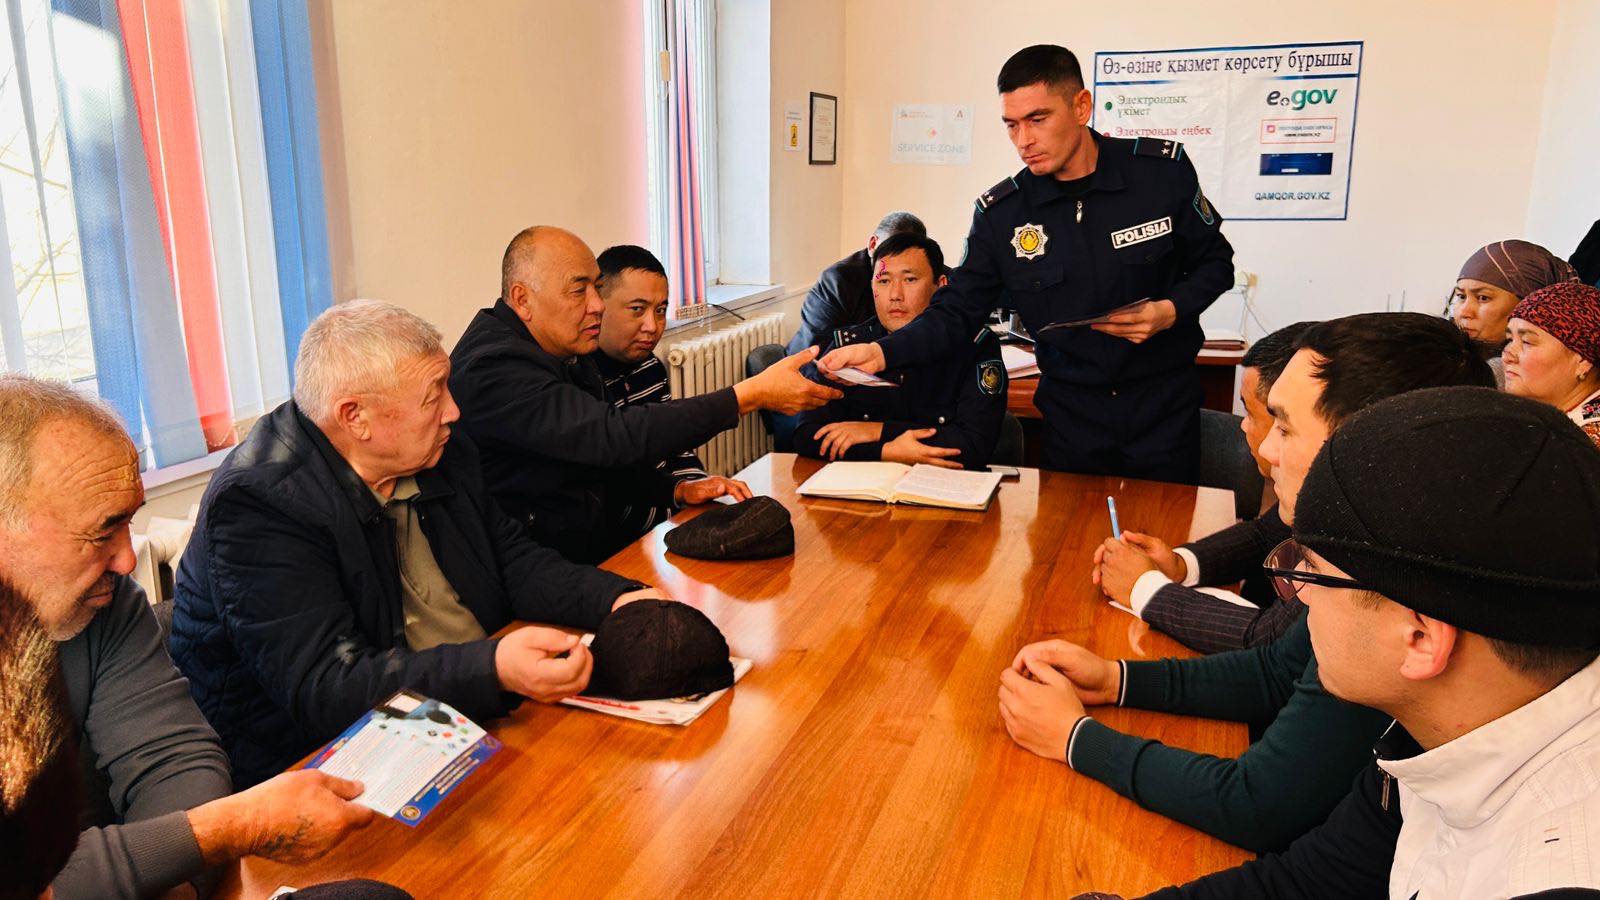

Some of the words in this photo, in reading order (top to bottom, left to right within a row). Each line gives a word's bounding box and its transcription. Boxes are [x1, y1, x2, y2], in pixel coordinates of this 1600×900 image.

[1103, 57, 1162, 74] Өз-өзіне
[1168, 58, 1220, 74] қызмет
[1224, 55, 1283, 74] көрсету
[1115, 127, 1178, 137] Электронды
[897, 144, 936, 153] SERVICE
[937, 144, 966, 153] ZONE
[1115, 221, 1169, 245] POLISIA
